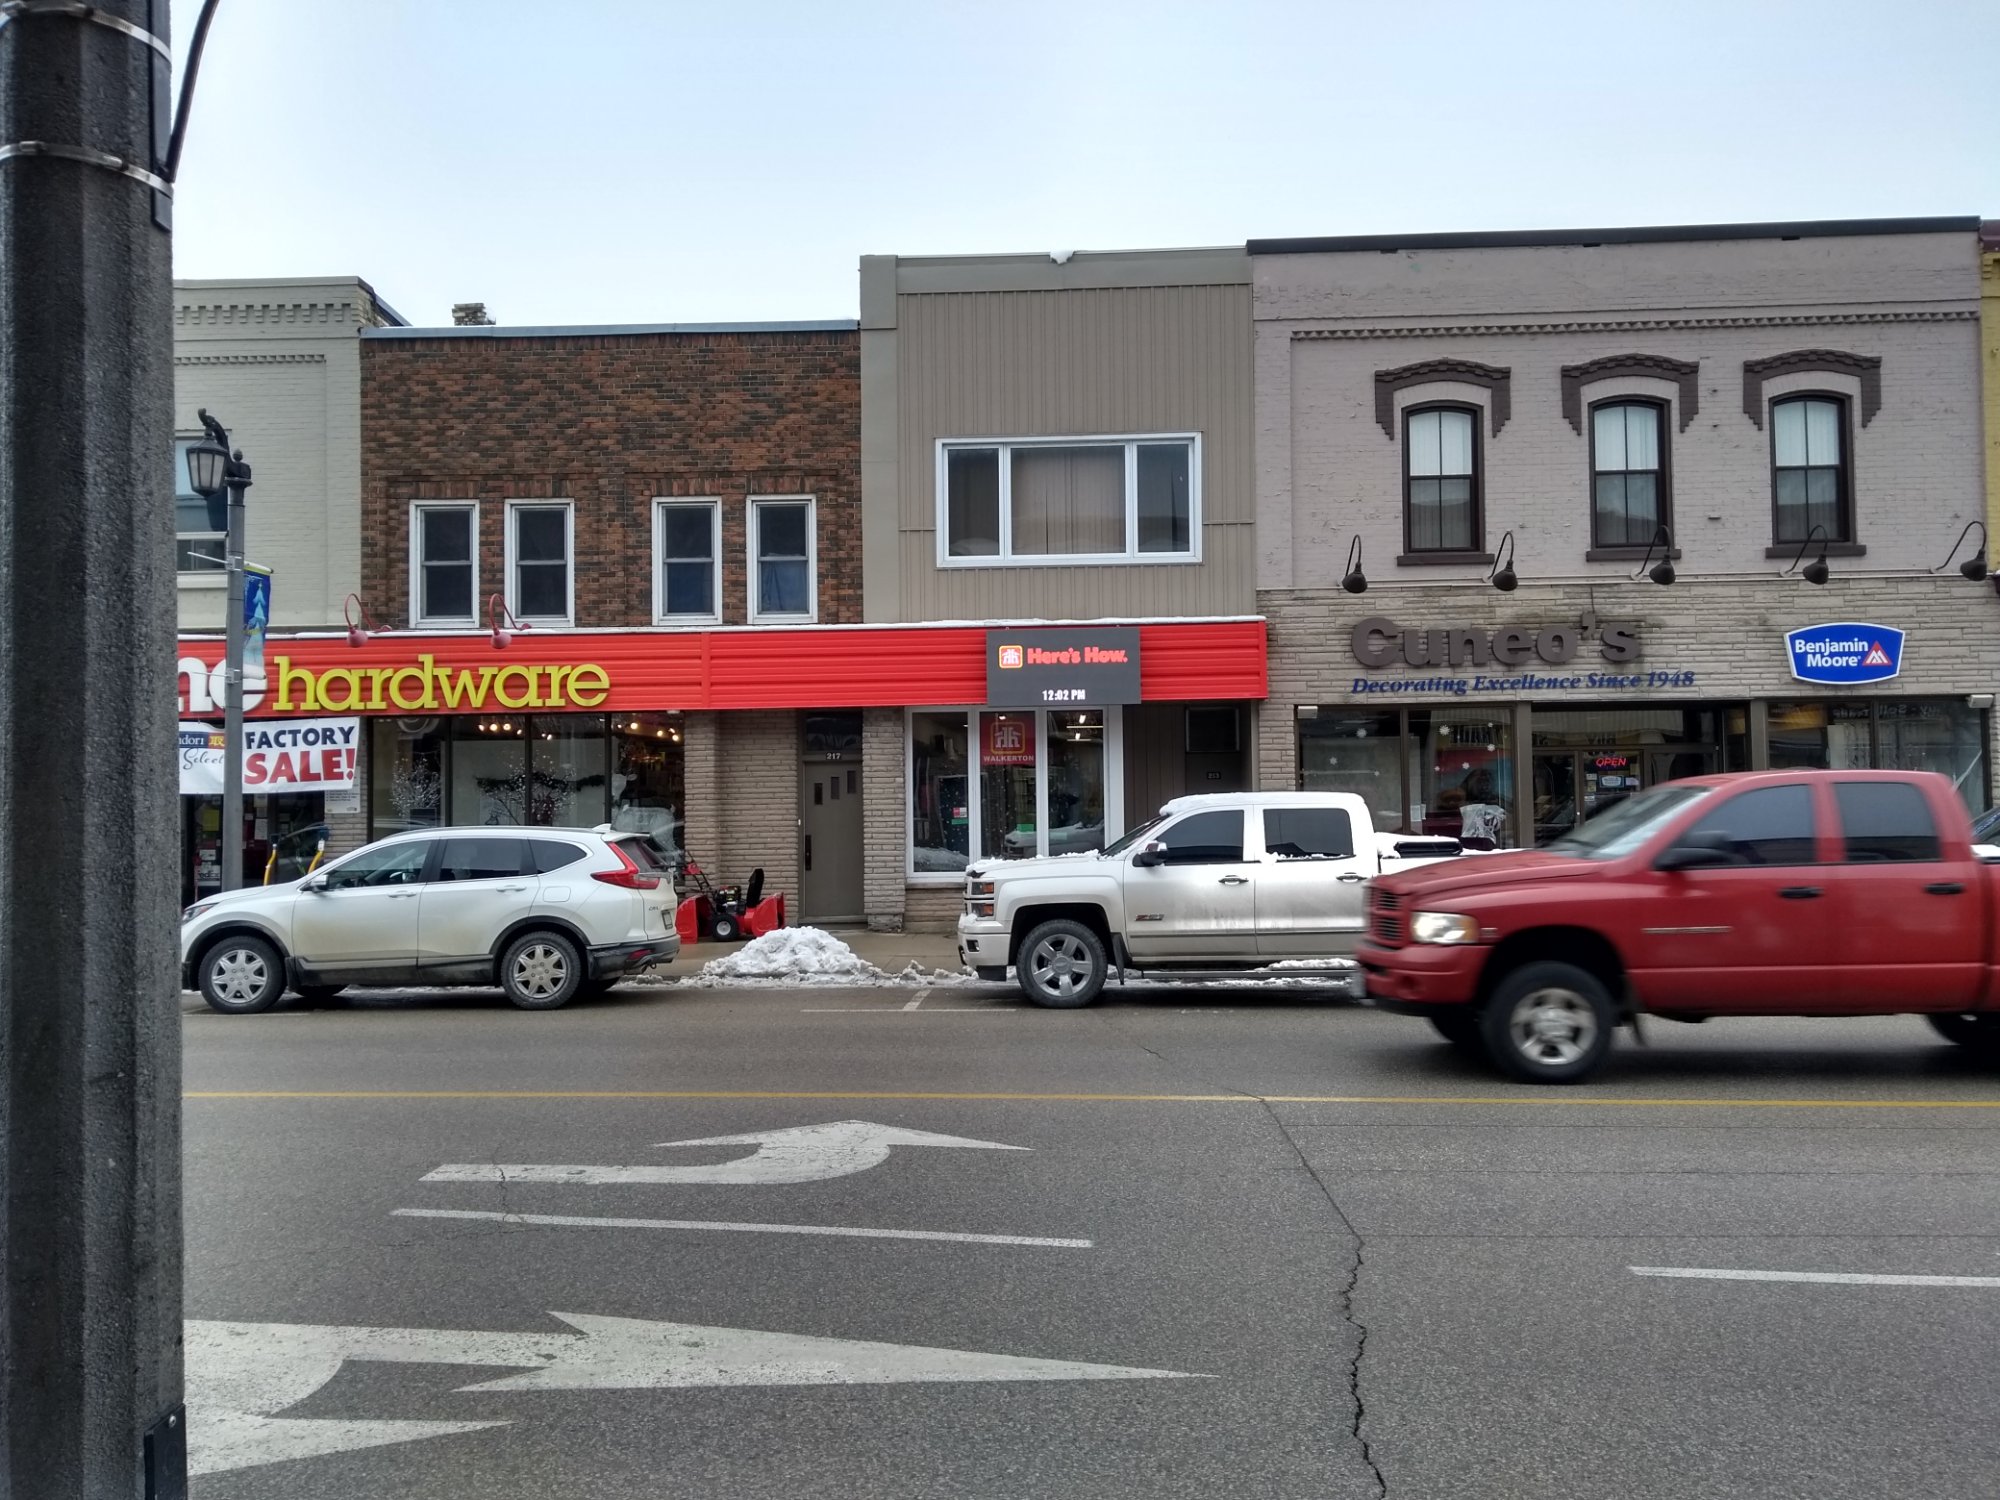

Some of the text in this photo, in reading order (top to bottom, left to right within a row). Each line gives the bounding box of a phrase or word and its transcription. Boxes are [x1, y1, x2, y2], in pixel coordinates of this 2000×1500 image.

[1351, 610, 1642, 668] Cuneo's
[1795, 638, 1868, 656] Benjamin
[1027, 646, 1128, 665] Here's How.
[1807, 654, 1859, 668] Moore
[272, 653, 610, 711] hardware
[1351, 670, 1696, 695] Decorating Excellence Since 1948
[1042, 689, 1086, 701] 12:02 PM
[245, 726, 356, 749] FACTORY
[826, 752, 841, 760] 217
[983, 754, 1034, 762] WALKERTON
[1596, 757, 1626, 767] OPEN
[244, 748, 356, 785] SALE!
